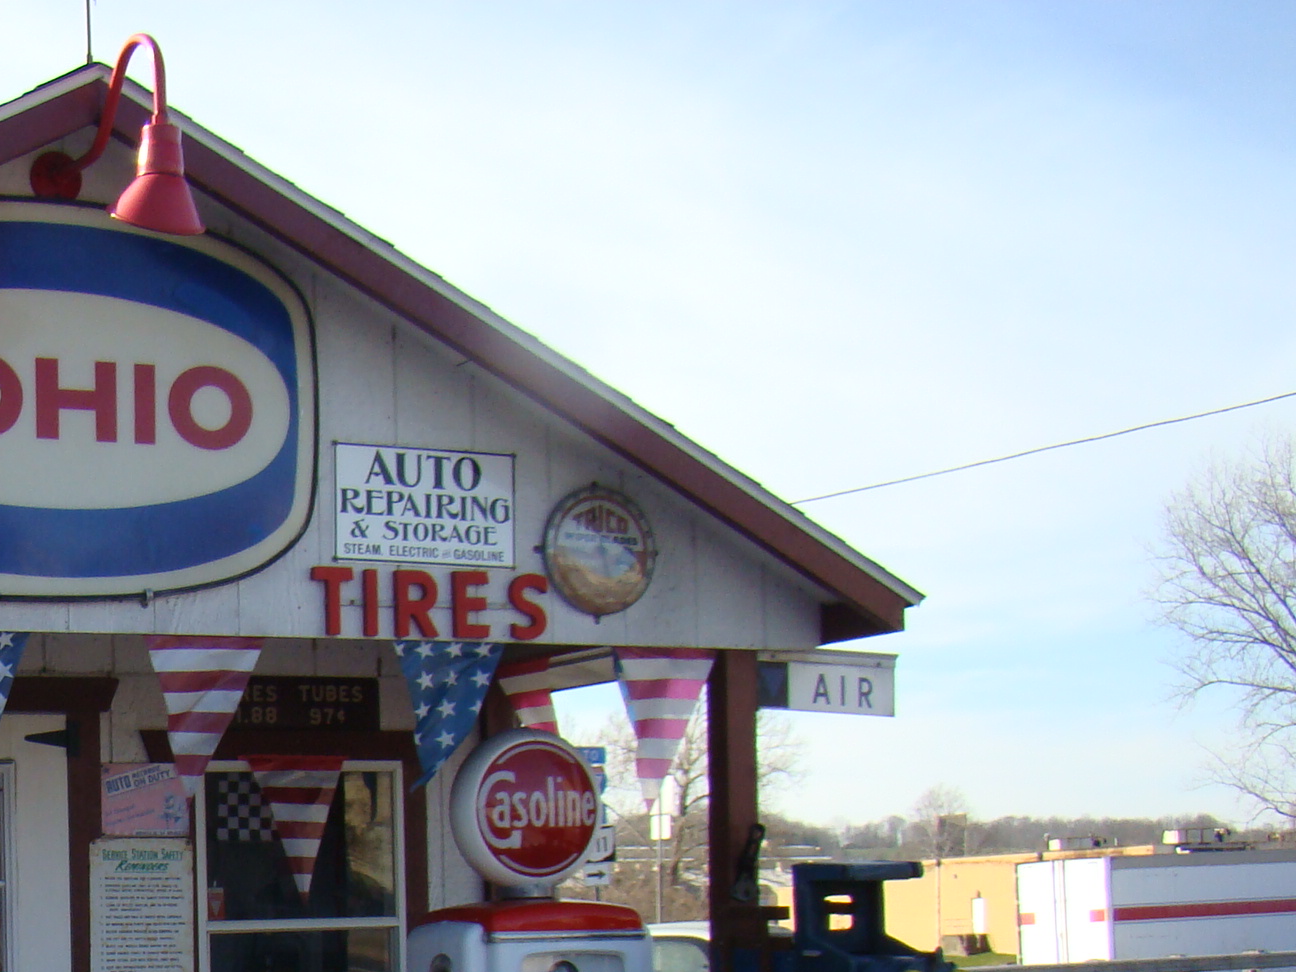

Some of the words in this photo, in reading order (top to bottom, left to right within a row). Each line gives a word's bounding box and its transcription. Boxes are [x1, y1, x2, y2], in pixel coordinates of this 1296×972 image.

[364, 449, 482, 491] AUTO
[340, 488, 510, 524] REPAIRING
[350, 518, 369, 539] &
[382, 520, 498, 546] STORAGE
[389, 545, 439, 559] ELECTRIC
[453, 549, 505, 563] GASOLINE
[311, 566, 548, 640] TIRES
[298, 684, 364, 703] TUBES
[812, 673, 873, 710] AIR
[105, 775, 131, 794] AUTO
[148, 769, 171, 783] DUTY
[477, 770, 597, 849] Gasoline
